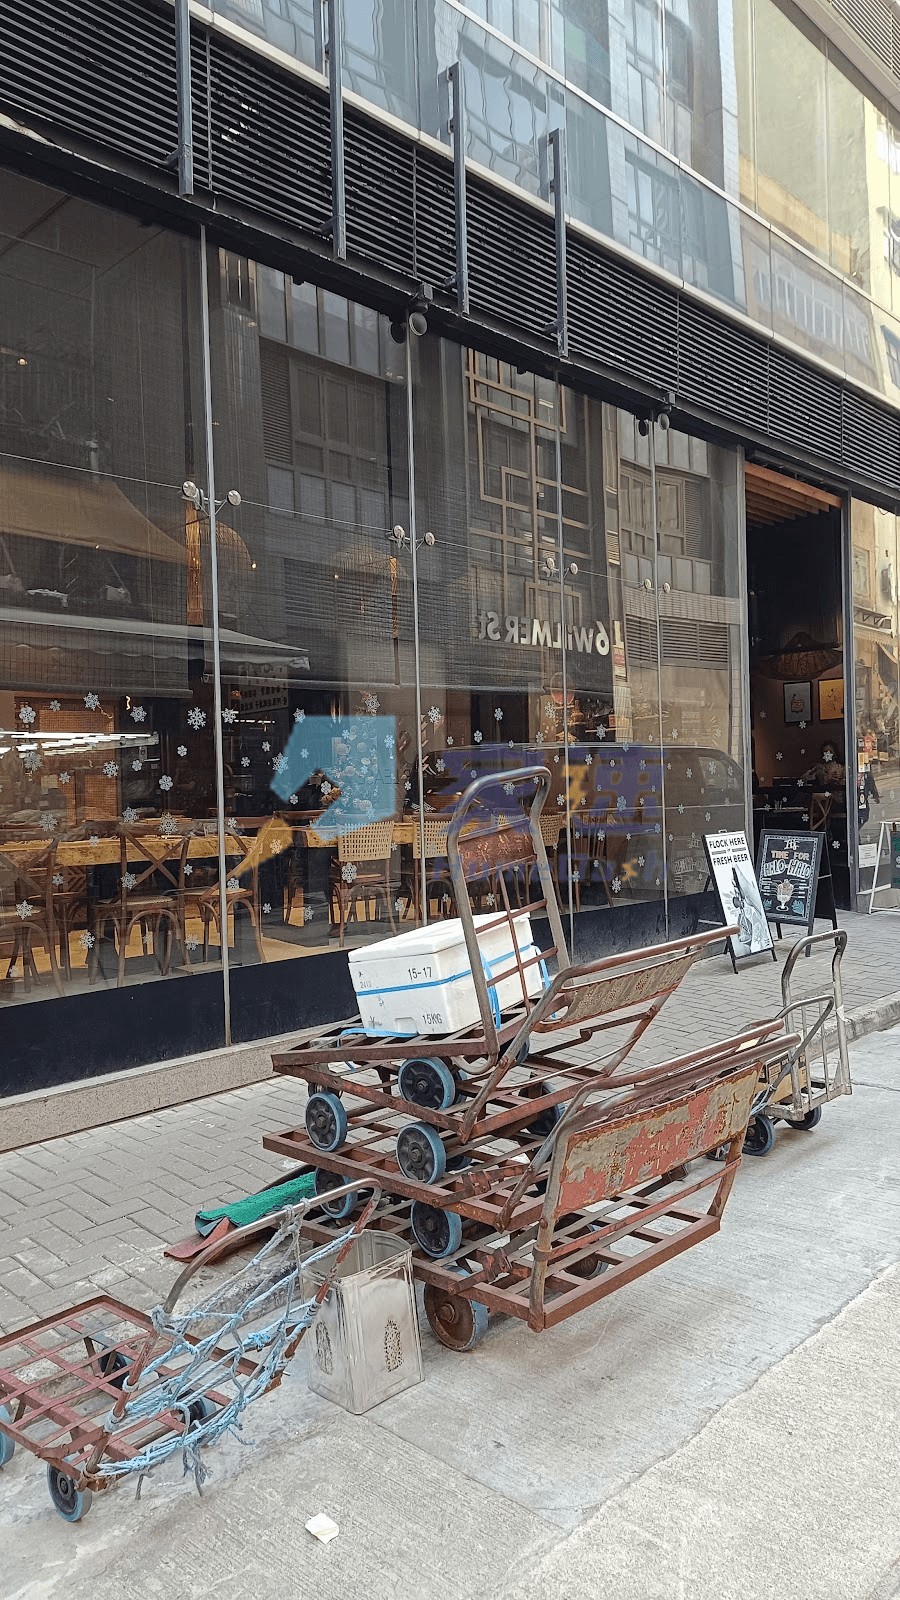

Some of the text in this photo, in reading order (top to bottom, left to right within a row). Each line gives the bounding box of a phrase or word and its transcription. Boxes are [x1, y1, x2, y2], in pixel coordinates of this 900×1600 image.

[709, 839, 729, 849] FLOCK
[729, 837, 745, 846] HERE
[713, 856, 733, 866] FRESH
[733, 853, 749, 863] BEER
[771, 850, 810, 861] TIME FOR
[408, 966, 432, 982] 15-17
[422, 1013, 443, 1025] 15KG
